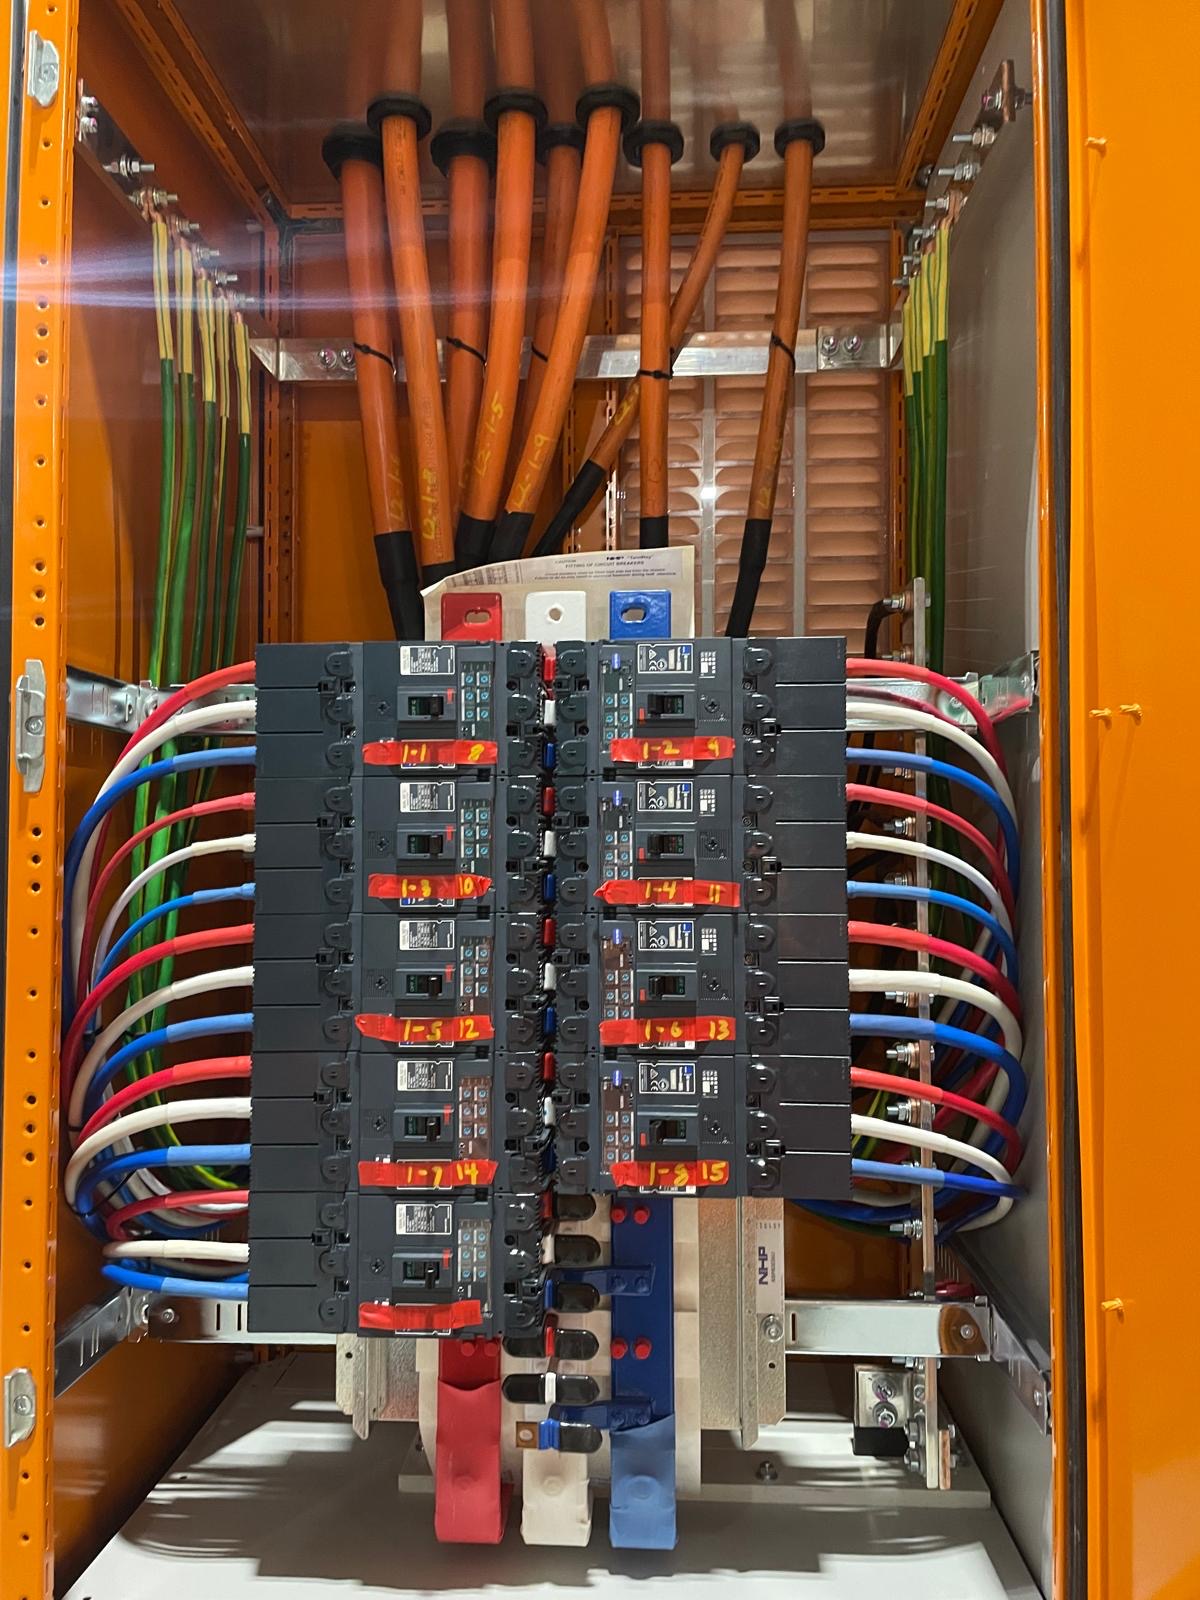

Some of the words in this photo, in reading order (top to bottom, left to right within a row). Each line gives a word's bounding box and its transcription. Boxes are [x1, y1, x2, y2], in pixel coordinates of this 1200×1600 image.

[402, 743, 427, 763] 1-1
[643, 739, 680, 759] 1-2
[458, 876, 474, 896] 10
[645, 880, 677, 900] 1-4
[403, 1019, 443, 1041] 1-5
[459, 1018, 480, 1039] 12
[645, 1020, 683, 1040] 1-6
[709, 1020, 730, 1040] 13
[456, 1162, 479, 1185] 14
[649, 1161, 689, 1187] 1-8
[702, 1161, 727, 1182] 15
[758, 1246, 768, 1285] NHP
